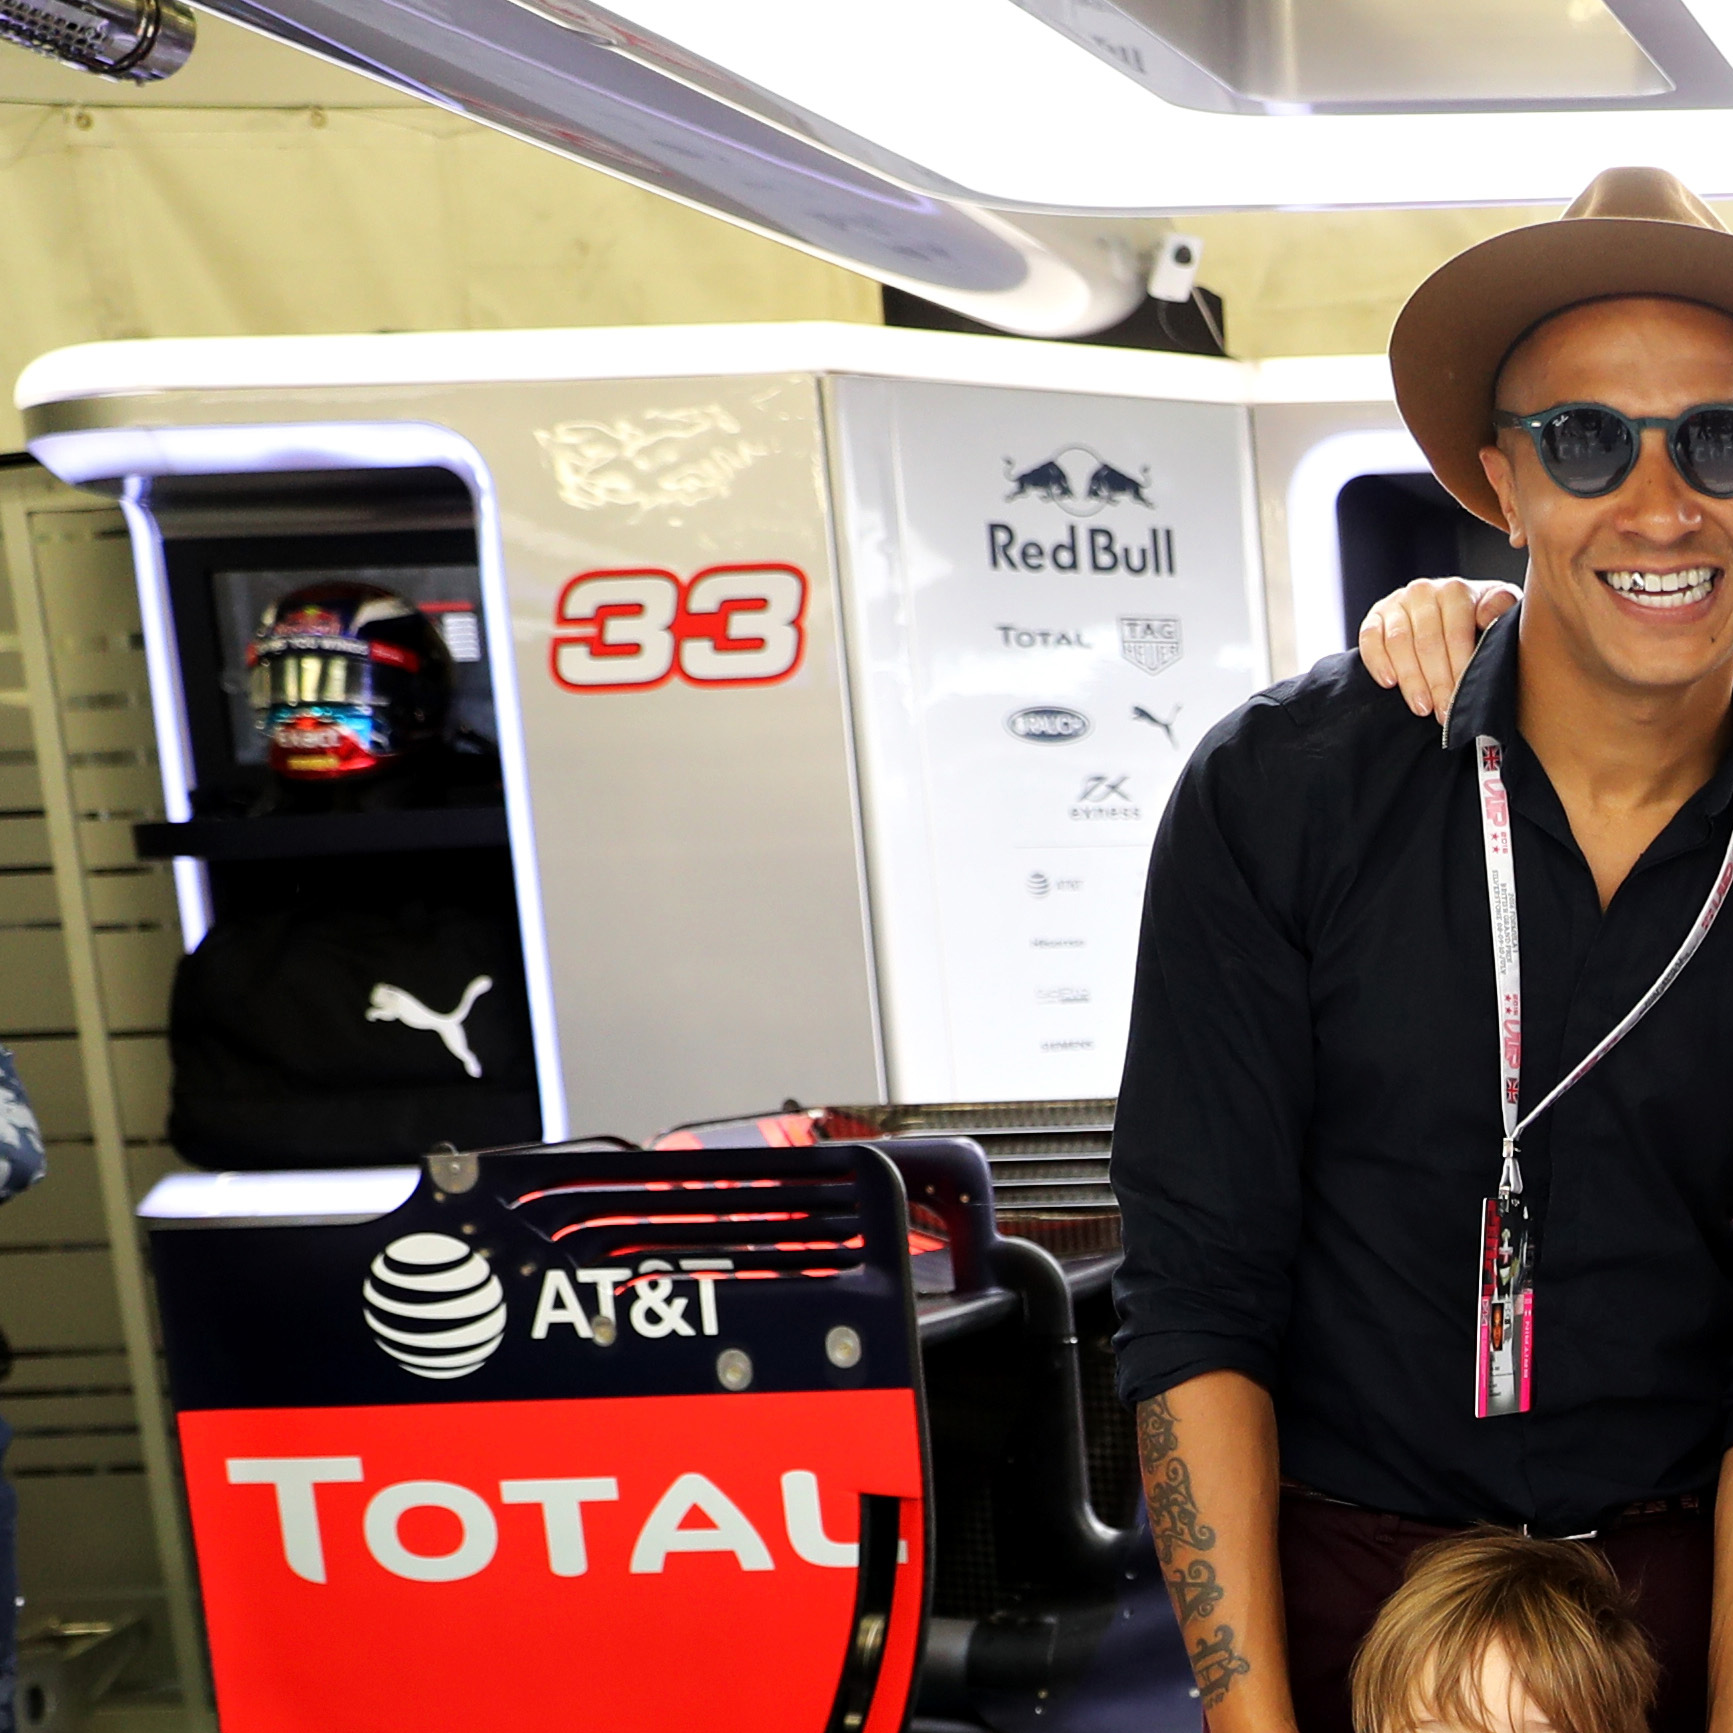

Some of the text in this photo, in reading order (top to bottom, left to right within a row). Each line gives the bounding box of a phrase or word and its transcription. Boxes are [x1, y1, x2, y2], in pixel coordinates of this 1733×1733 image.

[988, 522, 1174, 575] Red Bull
[549, 563, 812, 697] 33
[1126, 622, 1176, 640] TAG
[531, 1259, 733, 1341] AT&T
[226, 1456, 907, 1585] TOTAL
